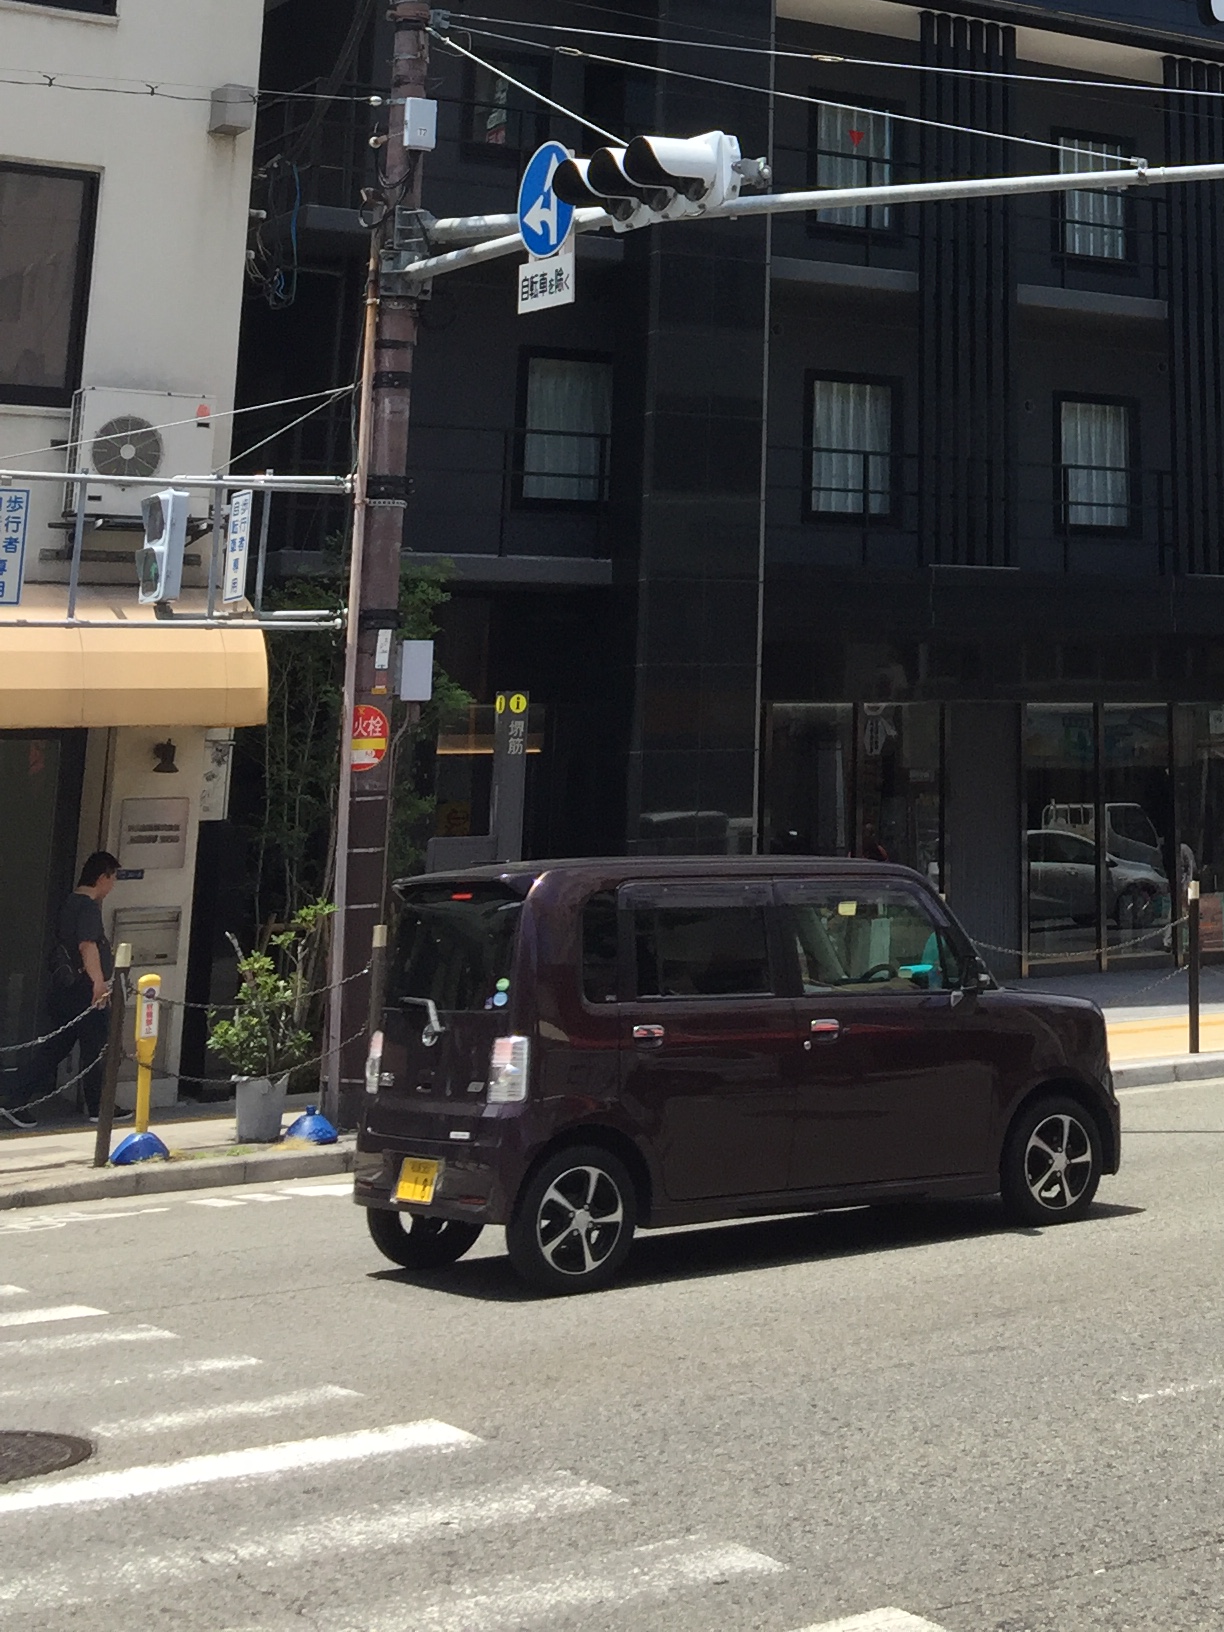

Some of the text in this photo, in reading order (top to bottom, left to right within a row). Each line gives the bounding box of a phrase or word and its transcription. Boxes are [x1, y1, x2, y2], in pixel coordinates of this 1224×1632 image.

[2, 495, 24, 554] 歩行者
[354, 716, 384, 737] 火栓
[507, 720, 525, 755] 堺筋
